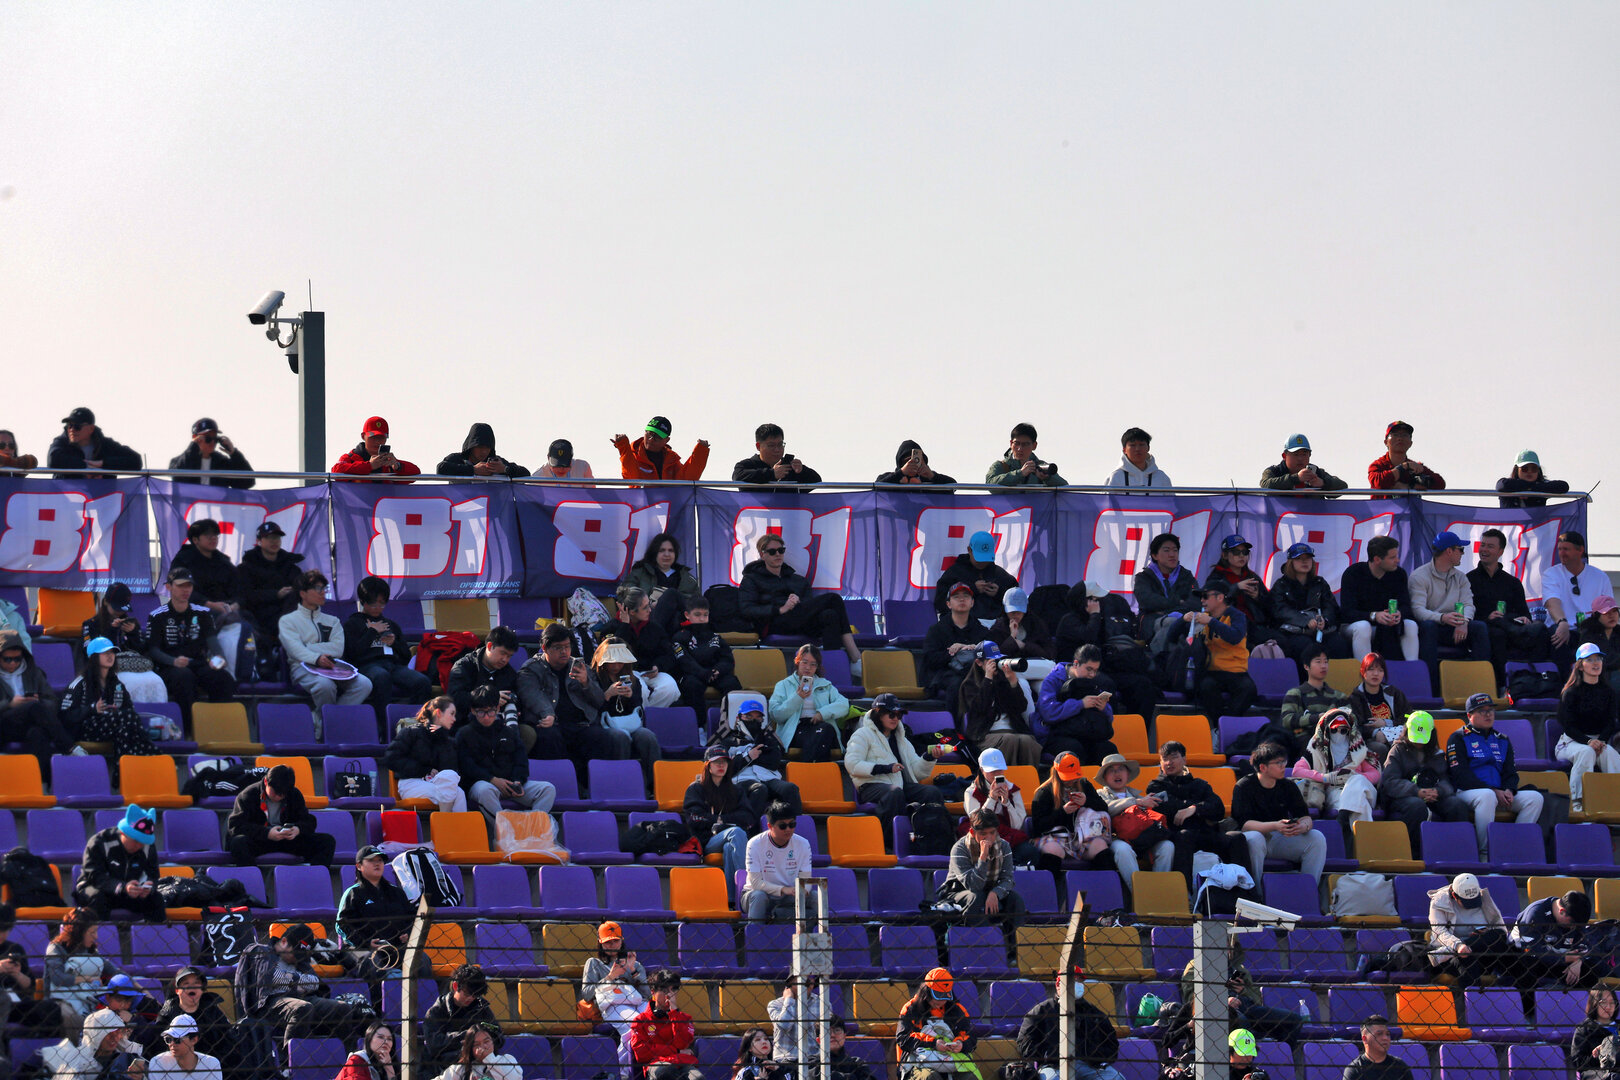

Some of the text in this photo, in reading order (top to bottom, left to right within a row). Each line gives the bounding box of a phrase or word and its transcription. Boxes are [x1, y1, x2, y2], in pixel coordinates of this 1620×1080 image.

[0, 491, 124, 573] 81
[366, 496, 489, 578] 81
[552, 500, 671, 581] 81
[730, 506, 853, 590] 81
[909, 505, 1033, 590] 81
[1083, 508, 1213, 594] 81
[1263, 511, 1395, 594] 81
